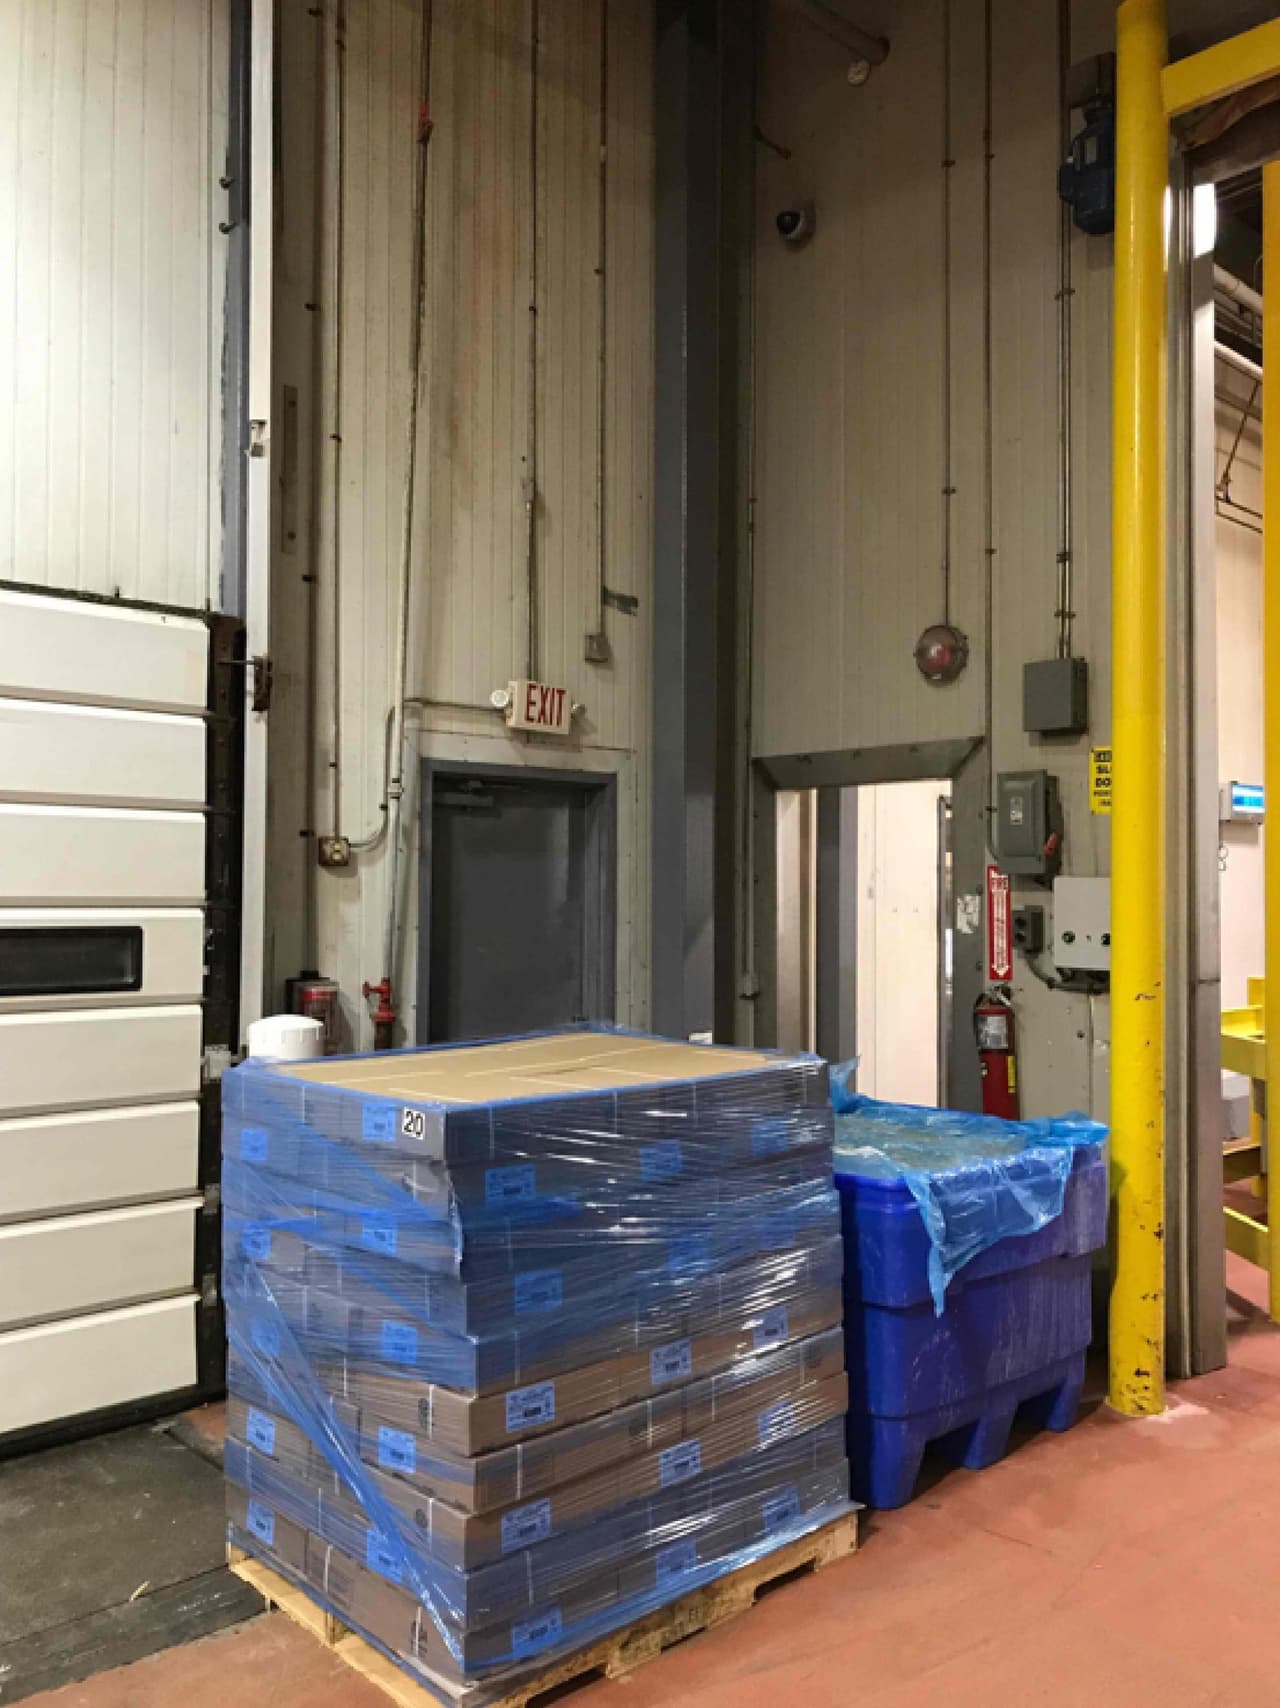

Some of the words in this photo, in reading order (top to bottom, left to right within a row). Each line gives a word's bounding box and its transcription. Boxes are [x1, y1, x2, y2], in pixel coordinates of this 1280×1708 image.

[524, 683, 567, 726] EXIT
[1096, 764, 1112, 774] SL
[1096, 777, 1112, 788] DO
[404, 1110, 423, 1137] 20
